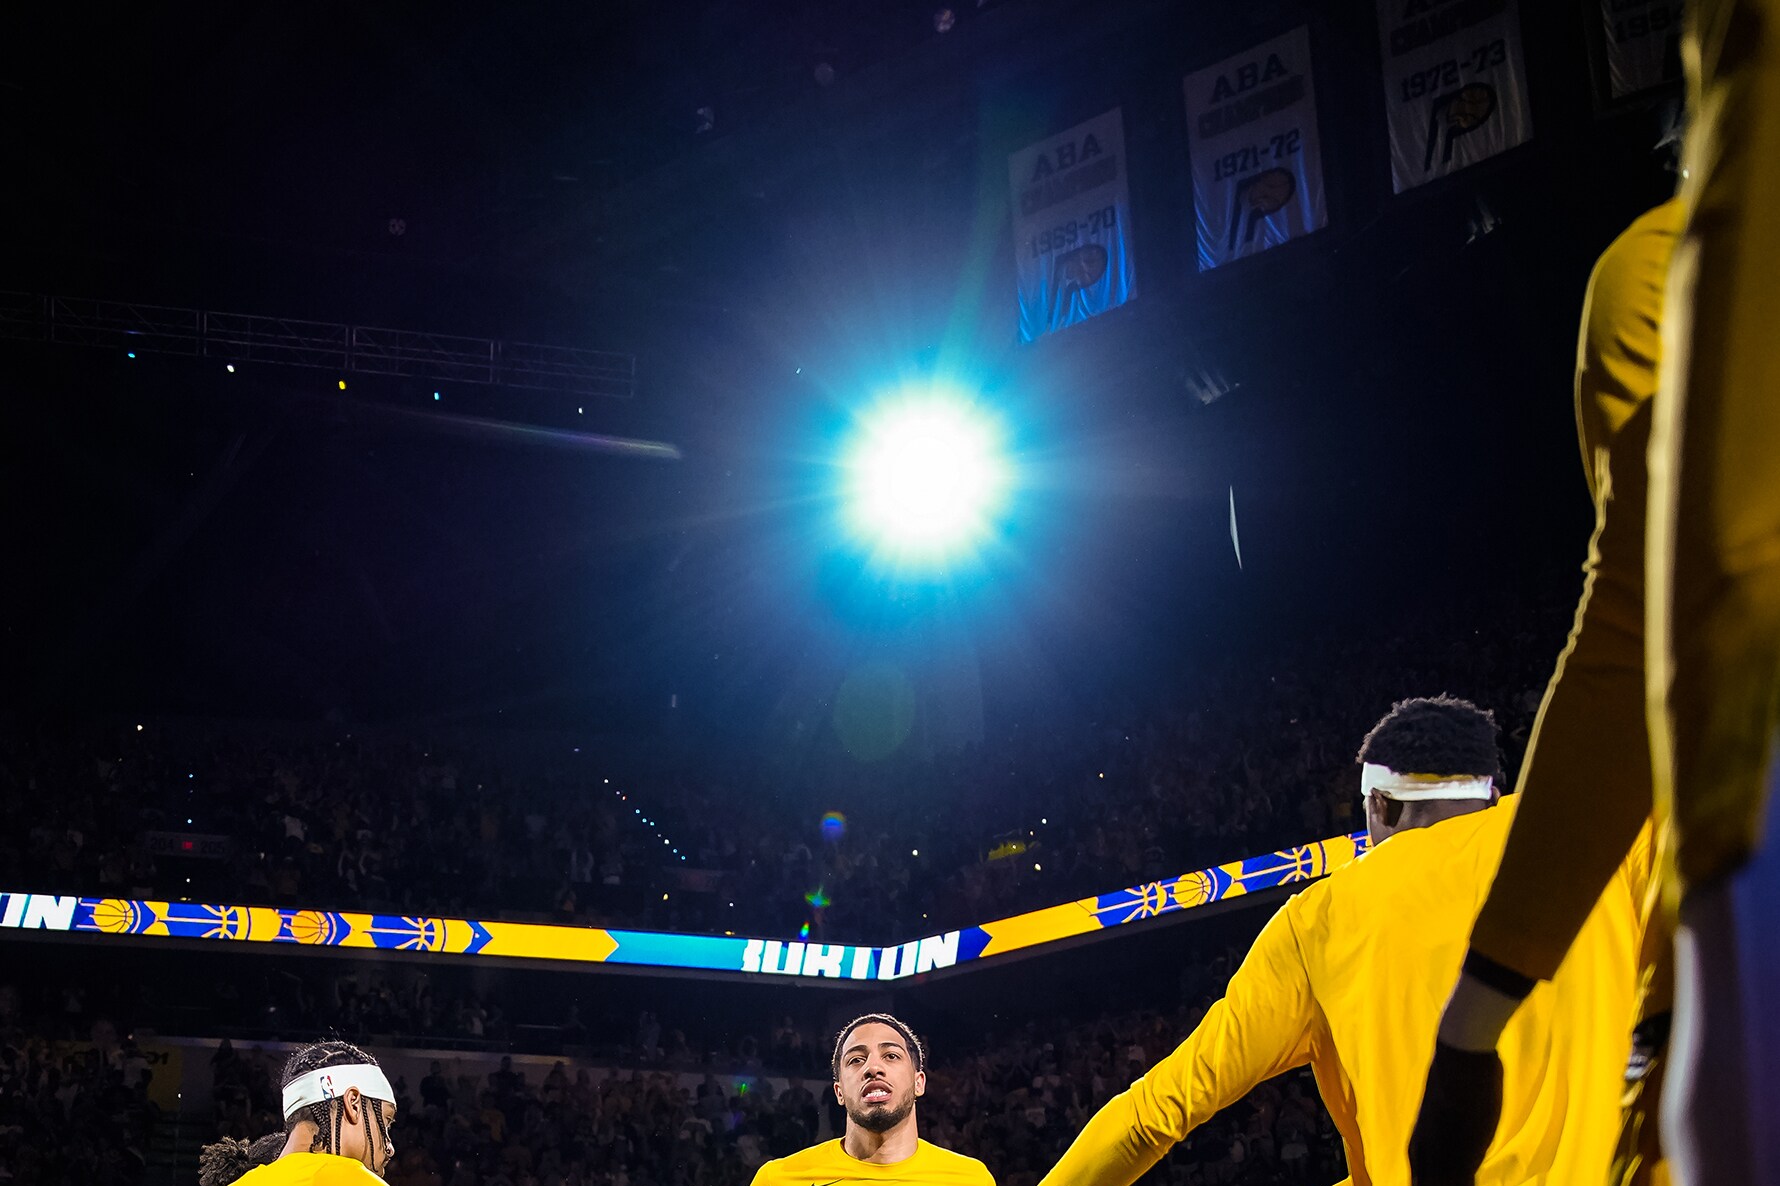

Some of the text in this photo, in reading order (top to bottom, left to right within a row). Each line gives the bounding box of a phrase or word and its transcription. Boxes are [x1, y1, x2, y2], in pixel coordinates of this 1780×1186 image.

[1210, 53, 1288, 104] ABA
[1401, 38, 1506, 102] 1972-73
[1031, 133, 1102, 183] ABA
[1213, 128, 1301, 182] 1971-72
[1031, 205, 1116, 258] 1969-70
